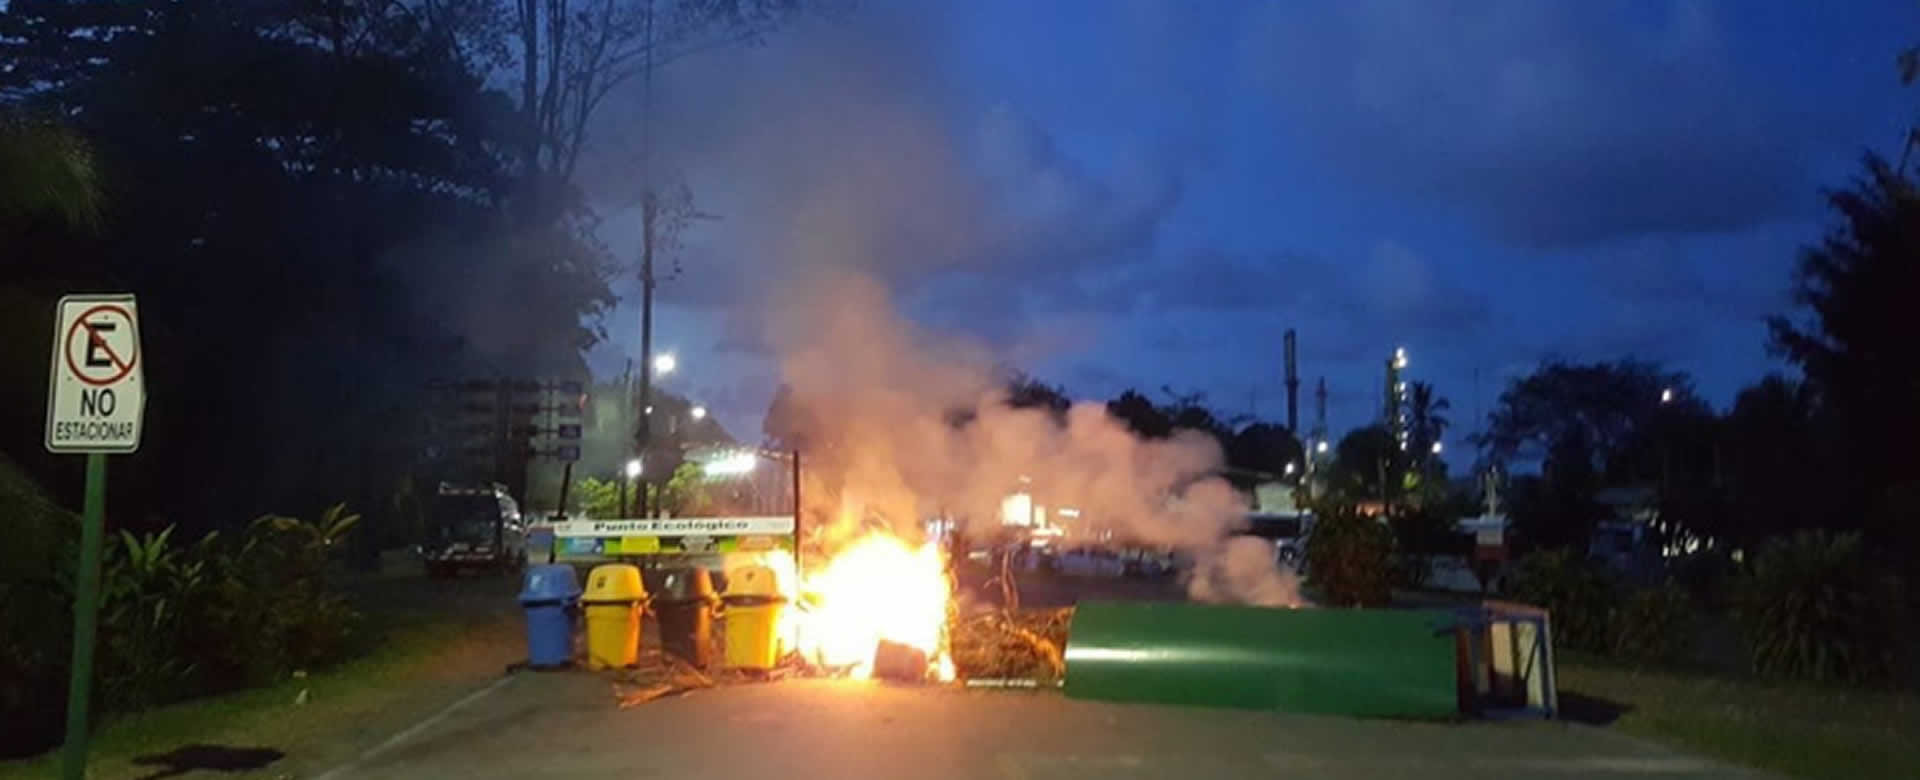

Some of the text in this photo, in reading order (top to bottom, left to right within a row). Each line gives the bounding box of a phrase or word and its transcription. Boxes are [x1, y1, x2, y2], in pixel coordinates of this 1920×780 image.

[86, 324, 116, 366] E
[80, 388, 116, 417] NO
[55, 421, 134, 441] ESTACIONAR
[593, 521, 648, 532] Punto
